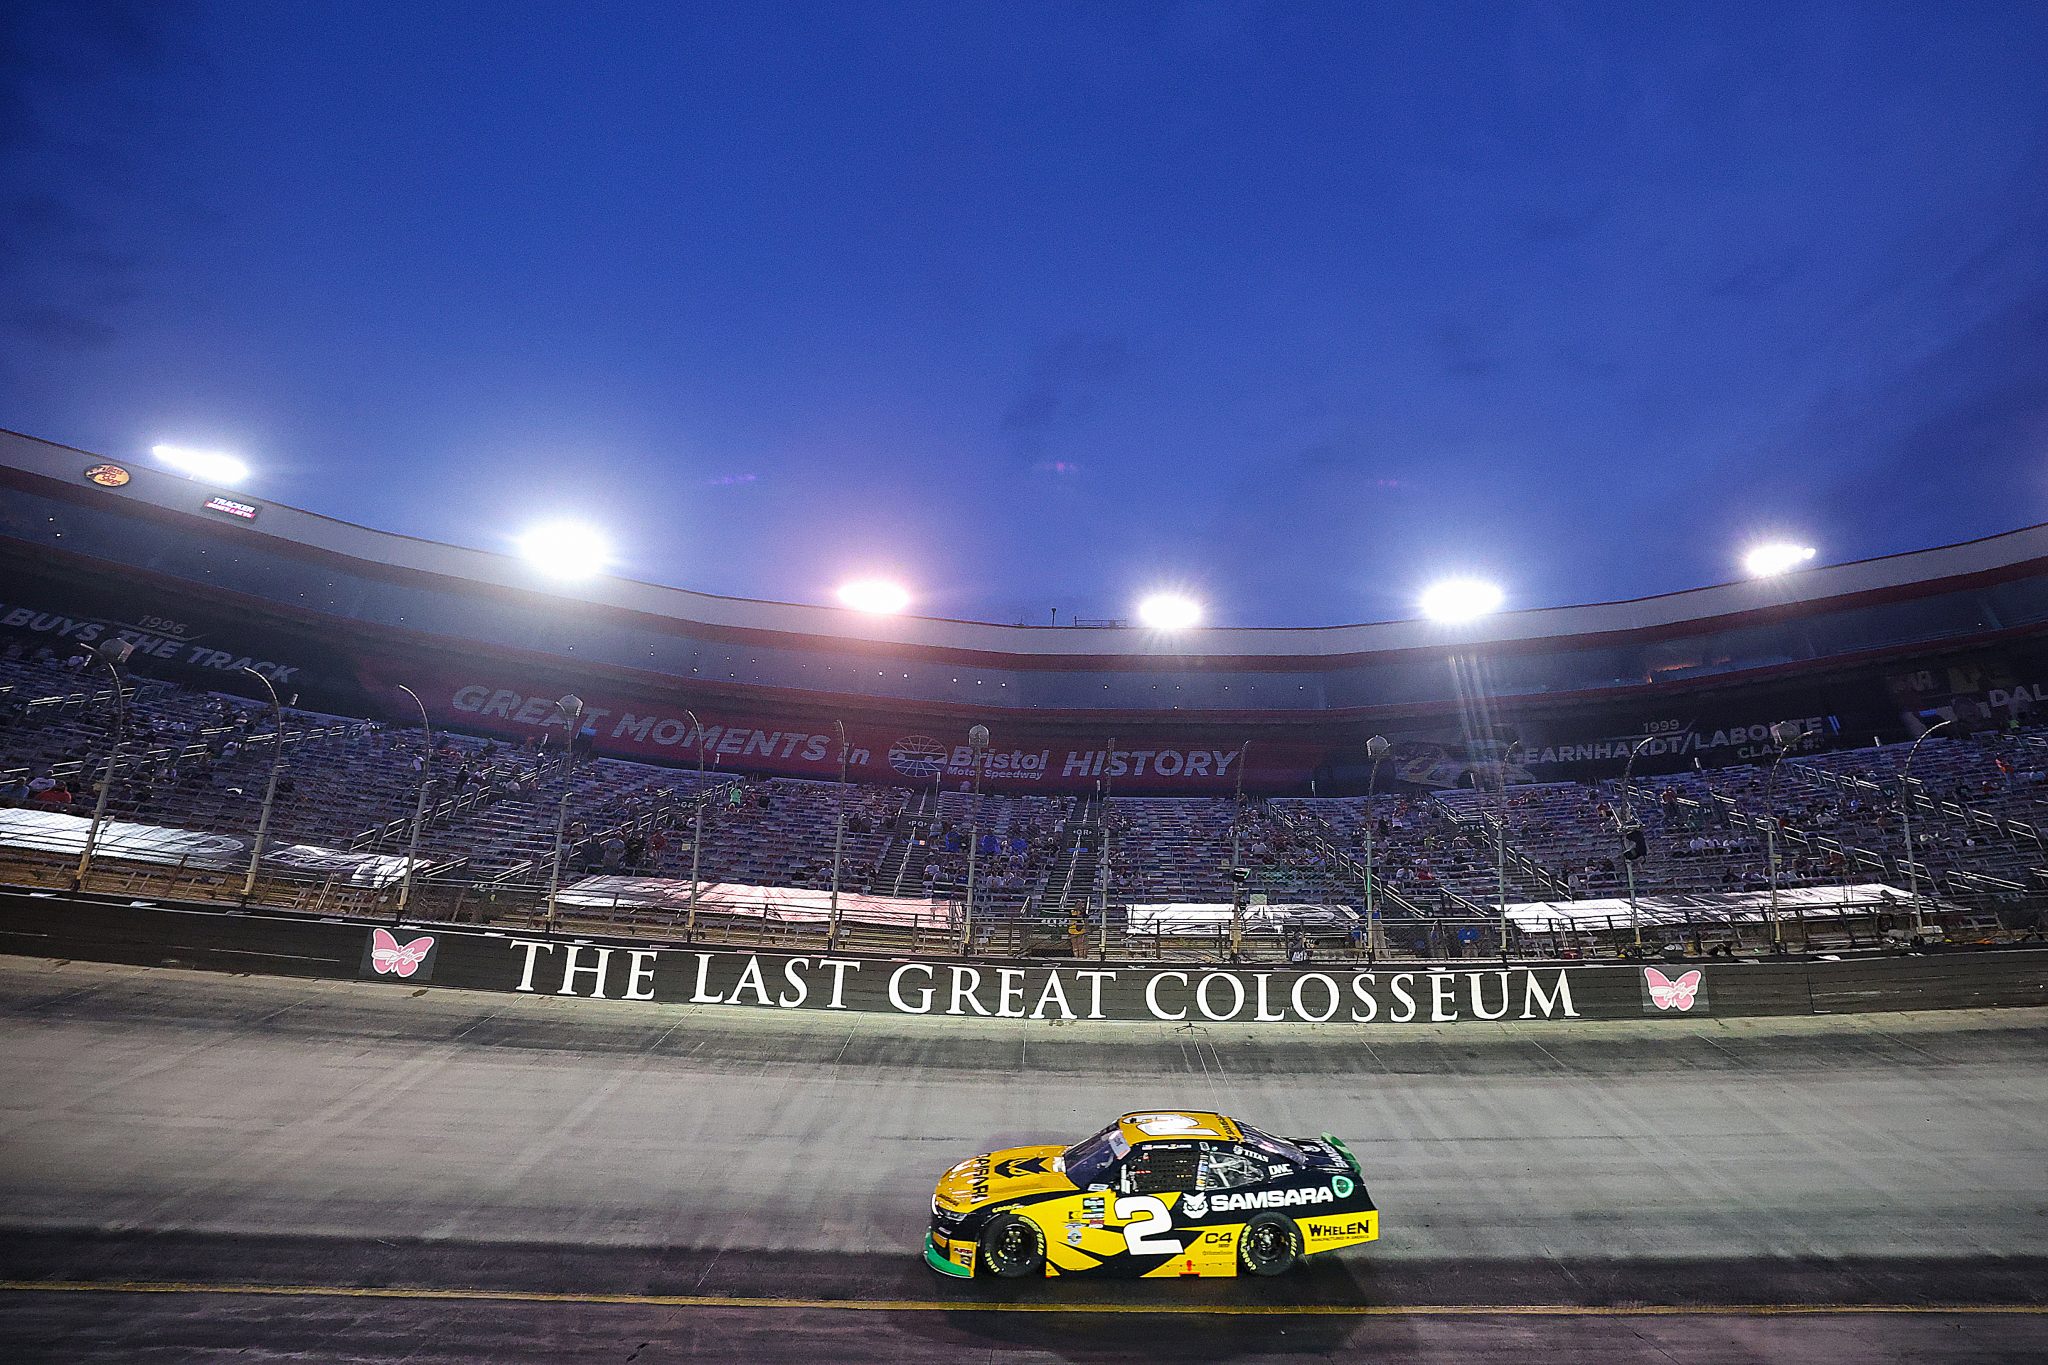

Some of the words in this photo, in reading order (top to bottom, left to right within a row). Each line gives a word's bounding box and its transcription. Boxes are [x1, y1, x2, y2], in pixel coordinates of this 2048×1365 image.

[212, 496, 256, 513] TRACKER
[138, 614, 188, 634] 1996
[1, 607, 105, 641] BUYS
[117, 628, 186, 659] THE
[186, 646, 299, 684] TRACK
[452, 685, 609, 731] GREAT
[611, 711, 830, 762] MOMENTS
[1643, 719, 1680, 732] 1999
[949, 745, 1050, 771] Bristol
[1062, 749, 1240, 778] HISTORY
[984, 769, 1044, 781] Speedway
[510, 940, 658, 1000] THE
[690, 953, 861, 1009] LAST
[887, 963, 1117, 1020] GREAT
[1145, 968, 1581, 1022] COLOSSEUM
[1243, 1149, 1270, 1163] TITAN
[1210, 1186, 1334, 1212] SAMSARA
[1114, 1195, 1184, 1256] 2
[1308, 1219, 1369, 1237] WHELEN
[1205, 1232, 1233, 1244] C4
